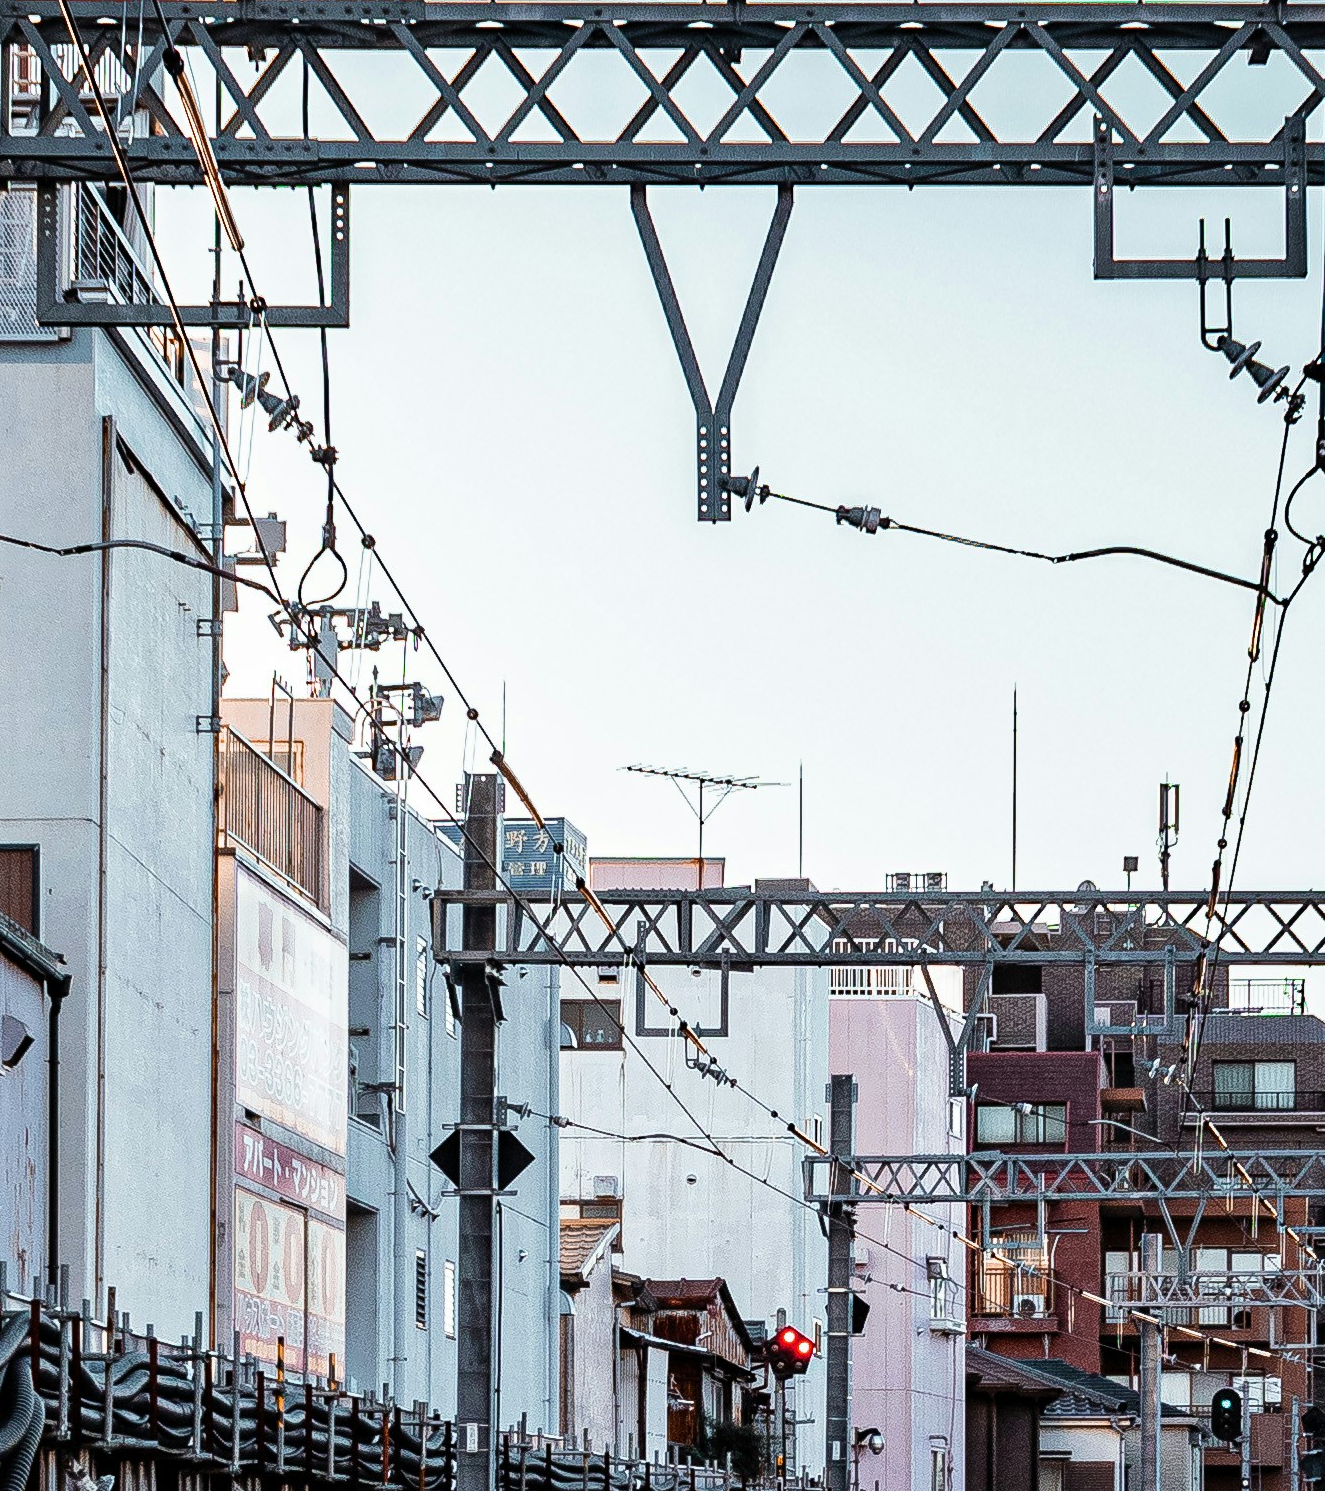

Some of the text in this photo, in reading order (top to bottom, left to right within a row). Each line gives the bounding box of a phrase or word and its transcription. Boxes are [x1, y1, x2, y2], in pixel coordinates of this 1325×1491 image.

[242, 1134, 339, 1211] アパート・マンション
